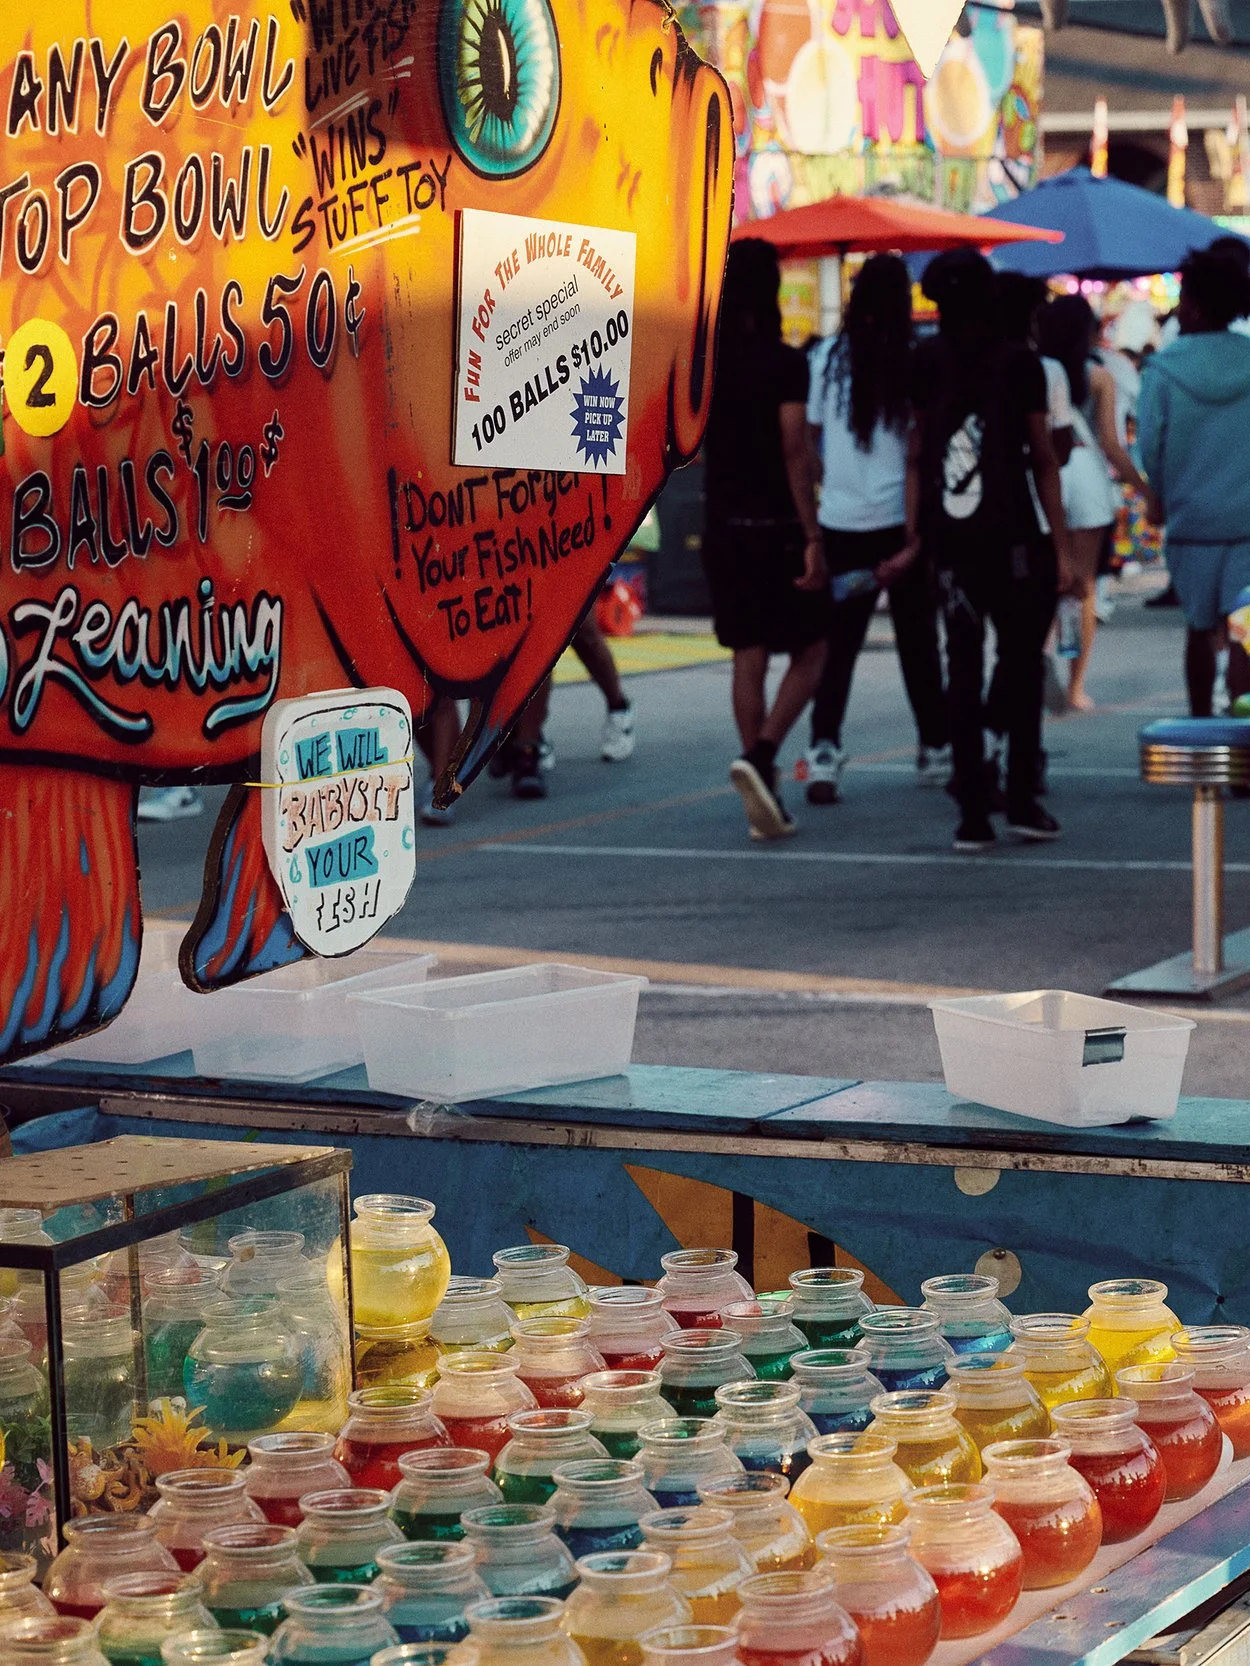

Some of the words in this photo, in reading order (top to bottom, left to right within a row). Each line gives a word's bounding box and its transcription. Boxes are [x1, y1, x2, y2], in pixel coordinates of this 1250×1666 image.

[8, 37, 129, 138] ANY
[140, 15, 295, 127] BOWL
[305, 26, 361, 113] LIVE
[0, 162, 101, 274] TOP
[119, 144, 290, 257] BOWL
[292, 168, 396, 254] STUFF
[402, 154, 453, 214] TOY
[494, 248, 521, 291] THE
[524, 231, 573, 265] WHOLE
[577, 238, 624, 301] FAMILY
[24, 344, 57, 408] 2
[78, 279, 246, 408] BALLS
[472, 288, 496, 343] FOR
[495, 308, 534, 352] secret
[535, 273, 579, 321] special
[504, 349, 523, 368] offer
[524, 332, 541, 354] may
[543, 318, 559, 338] end
[560, 302, 581, 326] soon
[463, 349, 482, 403] FUN
[471, 404, 507, 452] 100
[508, 354, 571, 423] BALLS
[571, 309, 630, 370] $10.00
[583, 394, 599, 408] WIN
[600, 396, 616, 409] NOW
[584, 411, 602, 425] PICK
[602, 413, 613, 426] UP
[586, 429, 610, 443] LATER
[10, 448, 180, 574] BALLS
[411, 535, 469, 594] Your
[473, 528, 538, 580] Fish
[538, 492, 596, 570] Need
[437, 596, 471, 642] To
[13, 577, 282, 730] Leaning
[297, 734, 332, 780] WE
[337, 731, 386, 771] WILL
[281, 775, 411, 854] BABYSIT
[308, 834, 374, 887] YOUR
